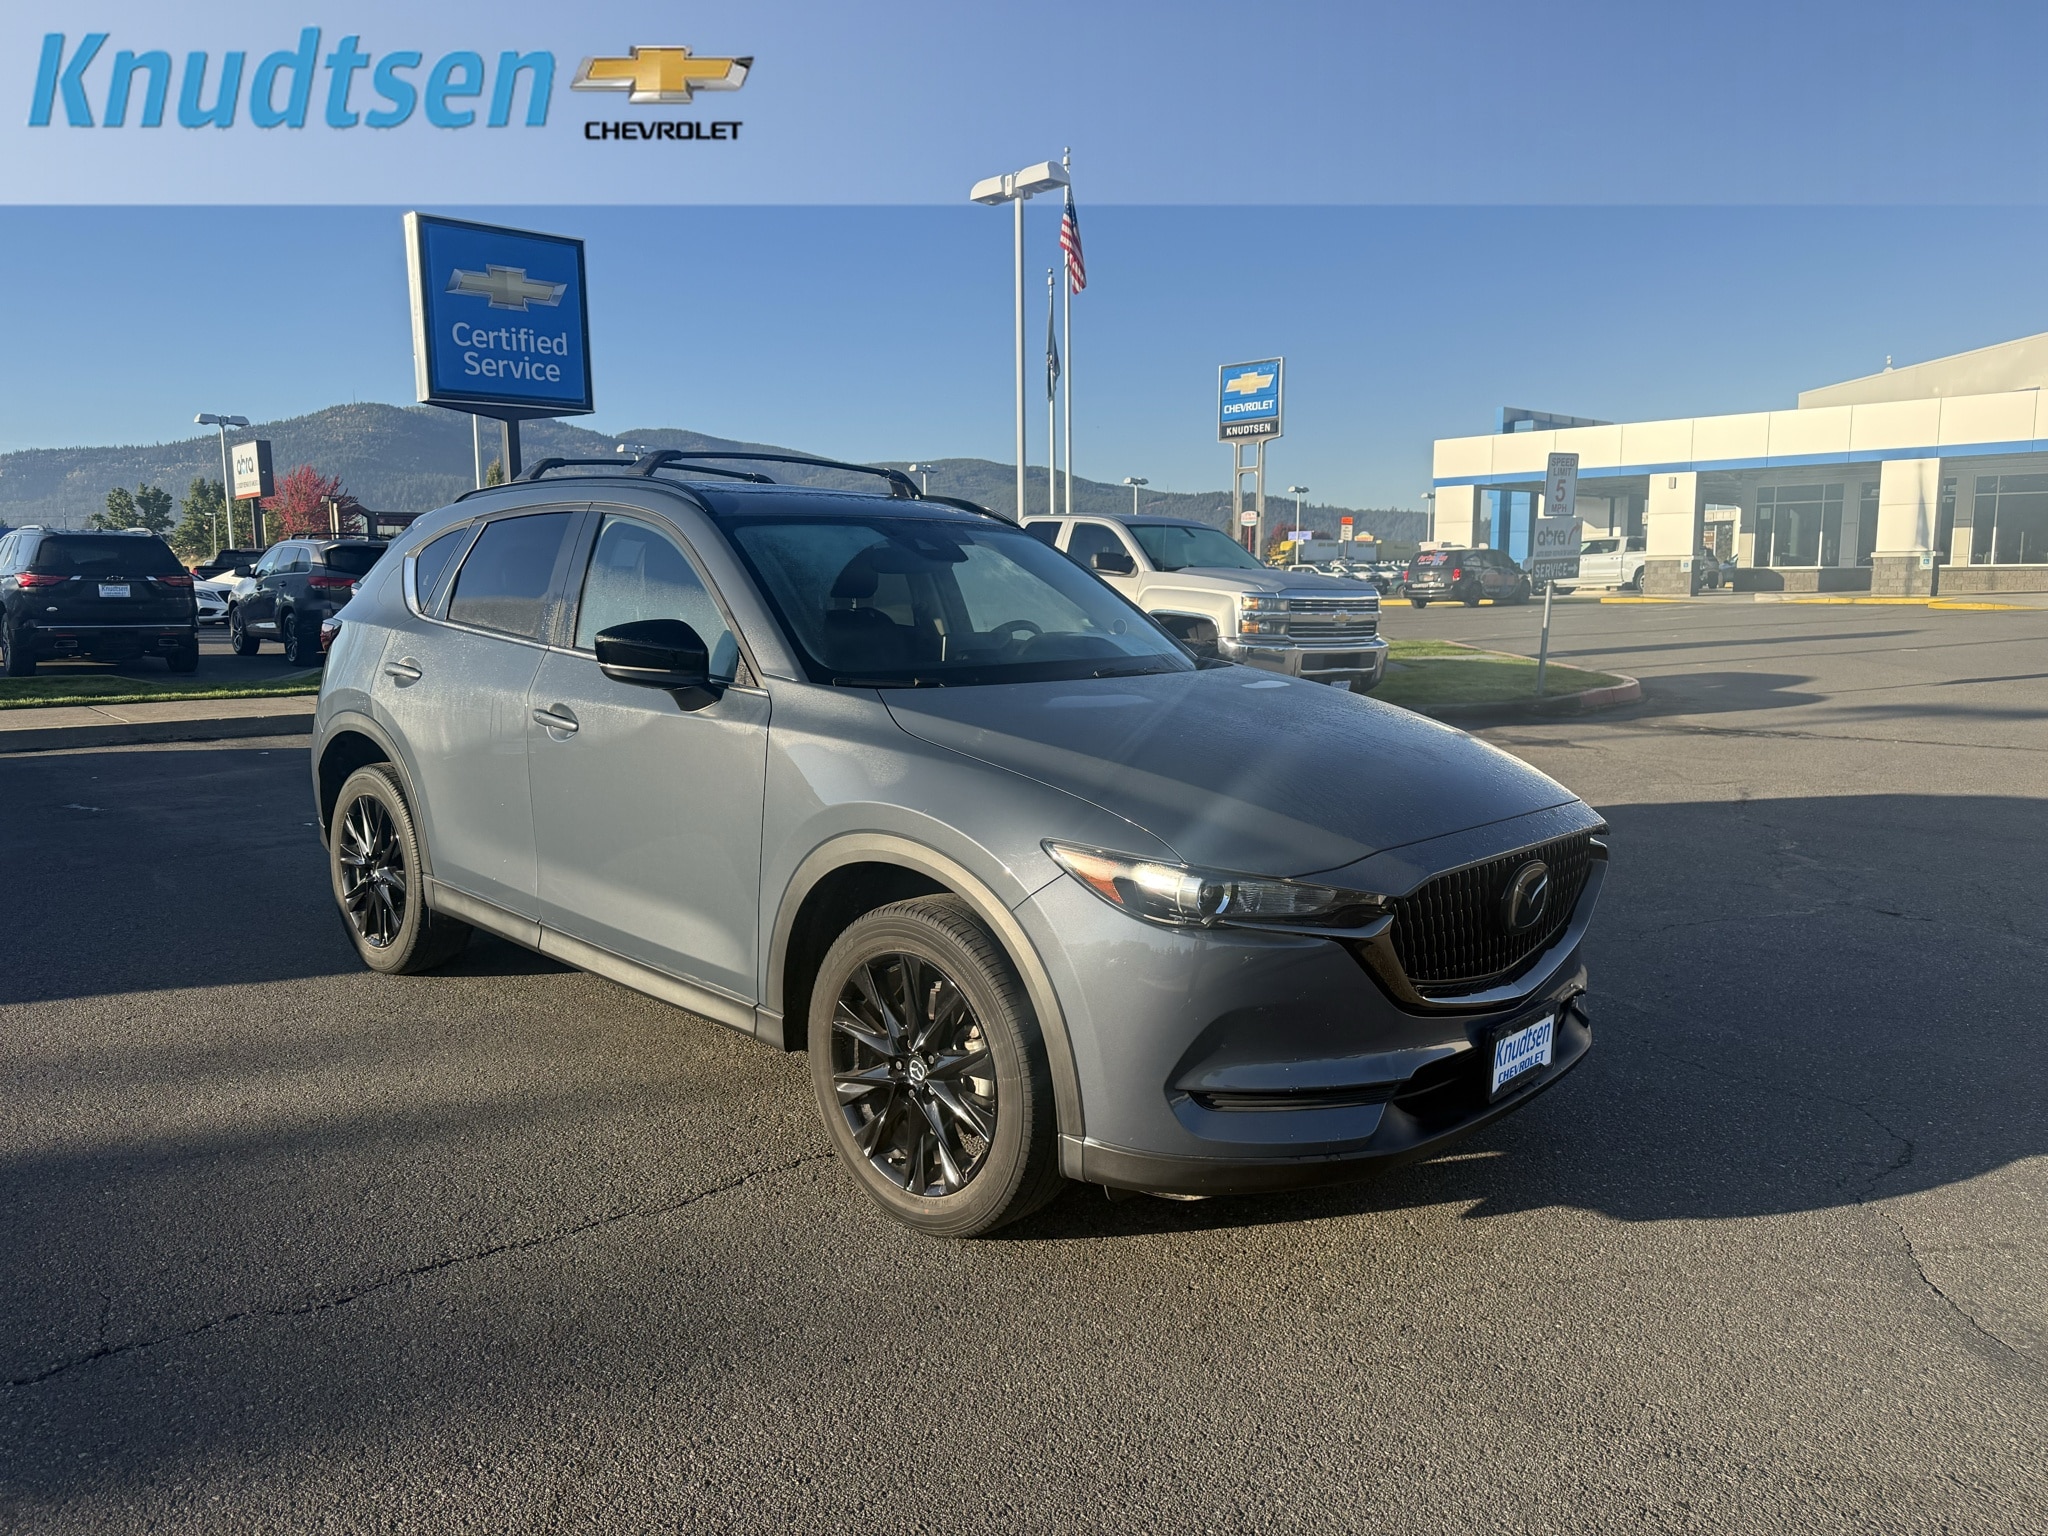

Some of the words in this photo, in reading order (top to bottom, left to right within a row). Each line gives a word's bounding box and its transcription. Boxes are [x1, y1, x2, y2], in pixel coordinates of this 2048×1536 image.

[452, 322, 568, 356] Certified
[464, 352, 561, 382] Service
[1224, 399, 1275, 414] CHEVROLET
[1226, 423, 1271, 436] KNUDTSEN
[1551, 457, 1576, 467] SPEED
[1553, 467, 1572, 477] LIMIT
[1555, 478, 1567, 503] 5
[1551, 503, 1567, 513] MPH
[1537, 526, 1566, 546] abra
[1534, 562, 1568, 578] SERVICE
[1494, 1022, 1551, 1070] Knudtsen
[1497, 1049, 1546, 1084] CHEVROLET
